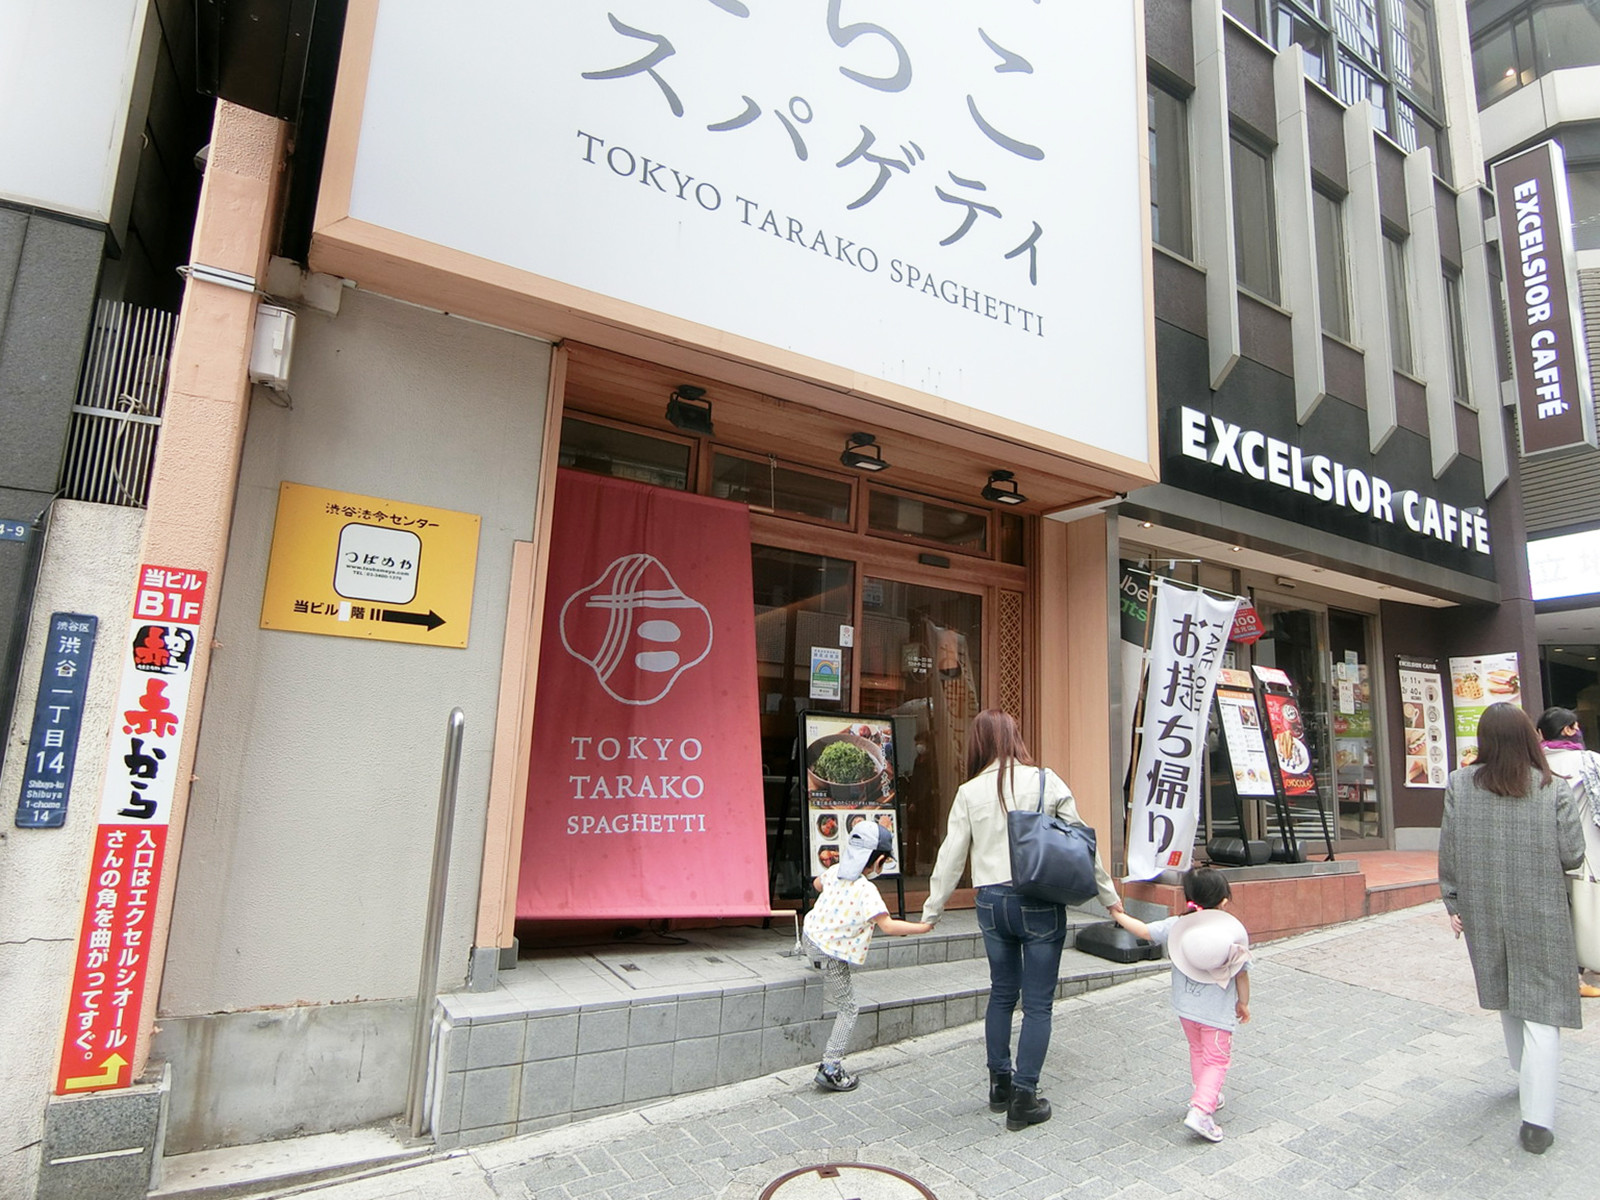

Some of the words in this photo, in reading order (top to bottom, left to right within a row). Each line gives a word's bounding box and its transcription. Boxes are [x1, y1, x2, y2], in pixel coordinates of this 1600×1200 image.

[581, 12, 1044, 286] スパゲティ
[577, 130, 722, 211] TOKYO
[736, 196, 879, 273] TARAKO
[890, 259, 1044, 338] SPAGHETTI
[1514, 178, 1551, 326] EXCELSIOR
[1531, 329, 1568, 420] CAFFÉ
[1181, 406, 1394, 523] EXCELSIOR
[1403, 490, 1490, 555] CAFFÉ
[345, 551, 412, 570] つばめや
[143, 569, 201, 590] 当ビル
[138, 591, 200, 620] B1F
[293, 600, 365, 620] 当ビル階
[57, 620, 90, 633] 渋谷区
[1198, 620, 1225, 670] TAKE
[44, 636, 81, 747] 渋谷一丁目
[1194, 676, 1207, 716] OUT
[1146, 613, 1208, 853] お持ち帰り
[36, 751, 65, 774] 14
[118, 678, 178, 819] 赤から
[571, 736, 702, 761] TOKYO
[26, 790, 62, 800] Shibuya
[28, 780, 65, 789] Shibuya-ku
[569, 775, 705, 799] TARAKO
[25, 800, 61, 809] 1-chome
[33, 810, 49, 822] 14
[567, 813, 706, 835] SPAGHETTI
[76, 830, 127, 1060] さんの角を曲がってすぐ。
[106, 828, 157, 1049] 入口はエクセルシオール
